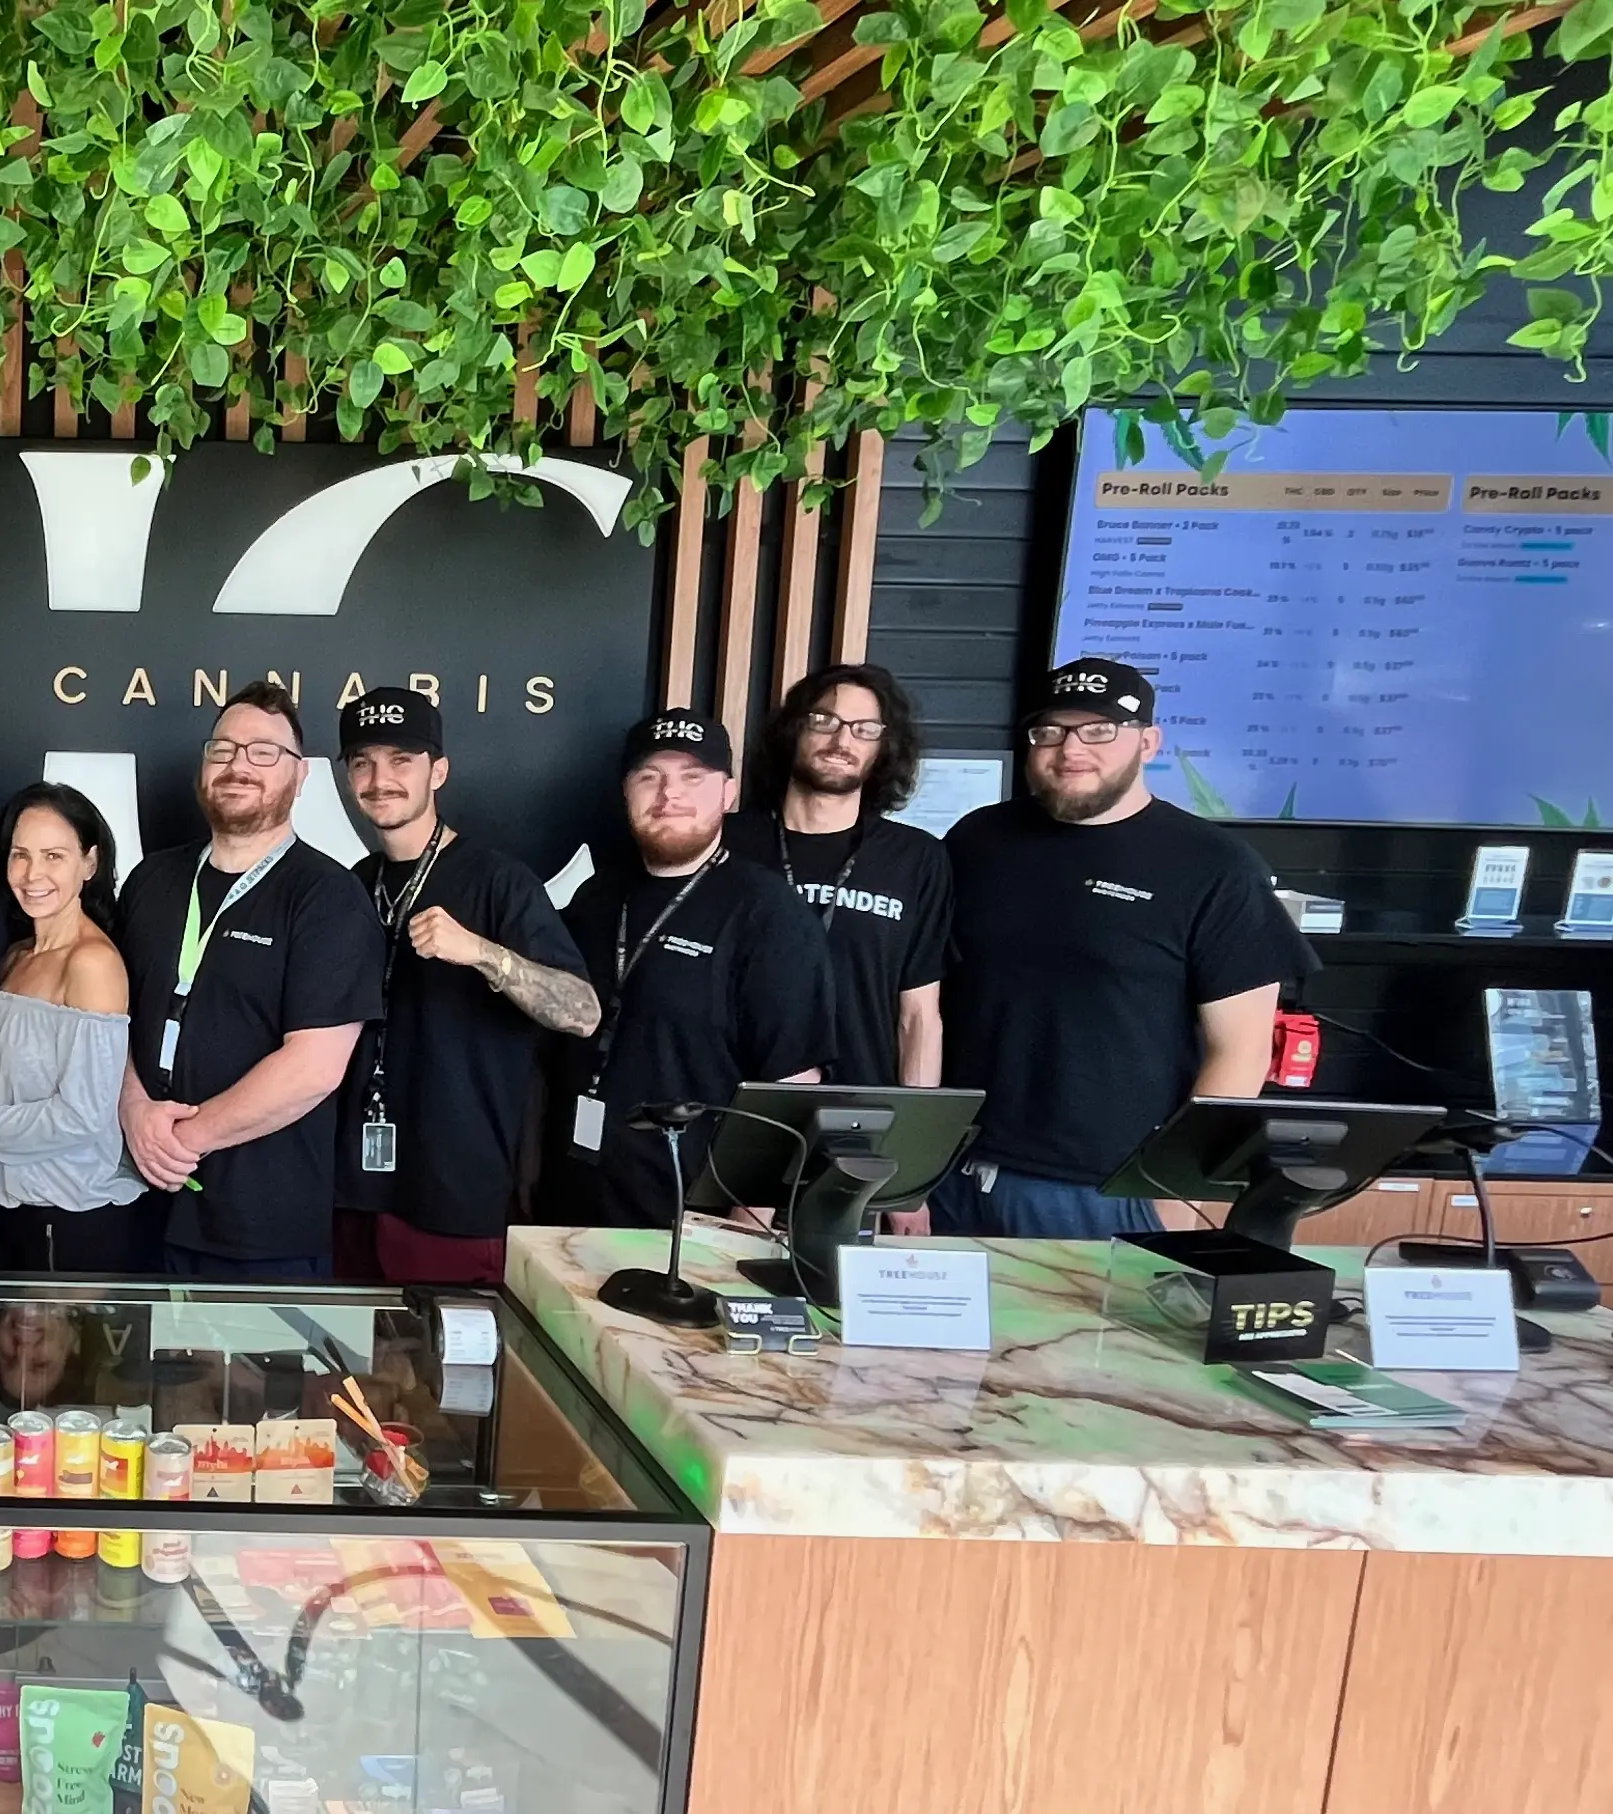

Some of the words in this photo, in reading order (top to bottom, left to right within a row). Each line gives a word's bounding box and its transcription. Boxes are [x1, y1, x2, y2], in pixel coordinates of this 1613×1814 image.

[1101, 482, 1172, 496] Pre-Roll
[1176, 483, 1229, 497] Packs
[1469, 486, 1543, 500] Pre-Roll
[1546, 486, 1602, 501] Packs
[1097, 520, 1129, 529] Bruce
[1132, 521, 1173, 531] Banner
[1191, 521, 1219, 531] Pack
[1463, 524, 1502, 536] Candy
[1139, 553, 1167, 563] Pack
[1115, 586, 1154, 596] Dream
[1084, 618, 1139, 630] Pineapple
[1142, 619, 1186, 630] Express
[1179, 653, 1208, 663] pack
[356, 701, 405, 727] THC
[1179, 717, 1207, 726] Pack
[650, 717, 704, 742] THC
[797, 883, 904, 921] TENDER
[879, 1269, 947, 1281] TREEHOUSE
[727, 1302, 774, 1315] THANK
[730, 1313, 759, 1324] YOU
[1230, 1300, 1316, 1330] TIPS
[57, 1762, 93, 1775] Stress
[57, 1778, 82, 1790] Free
[57, 1789, 85, 1805] Mind
